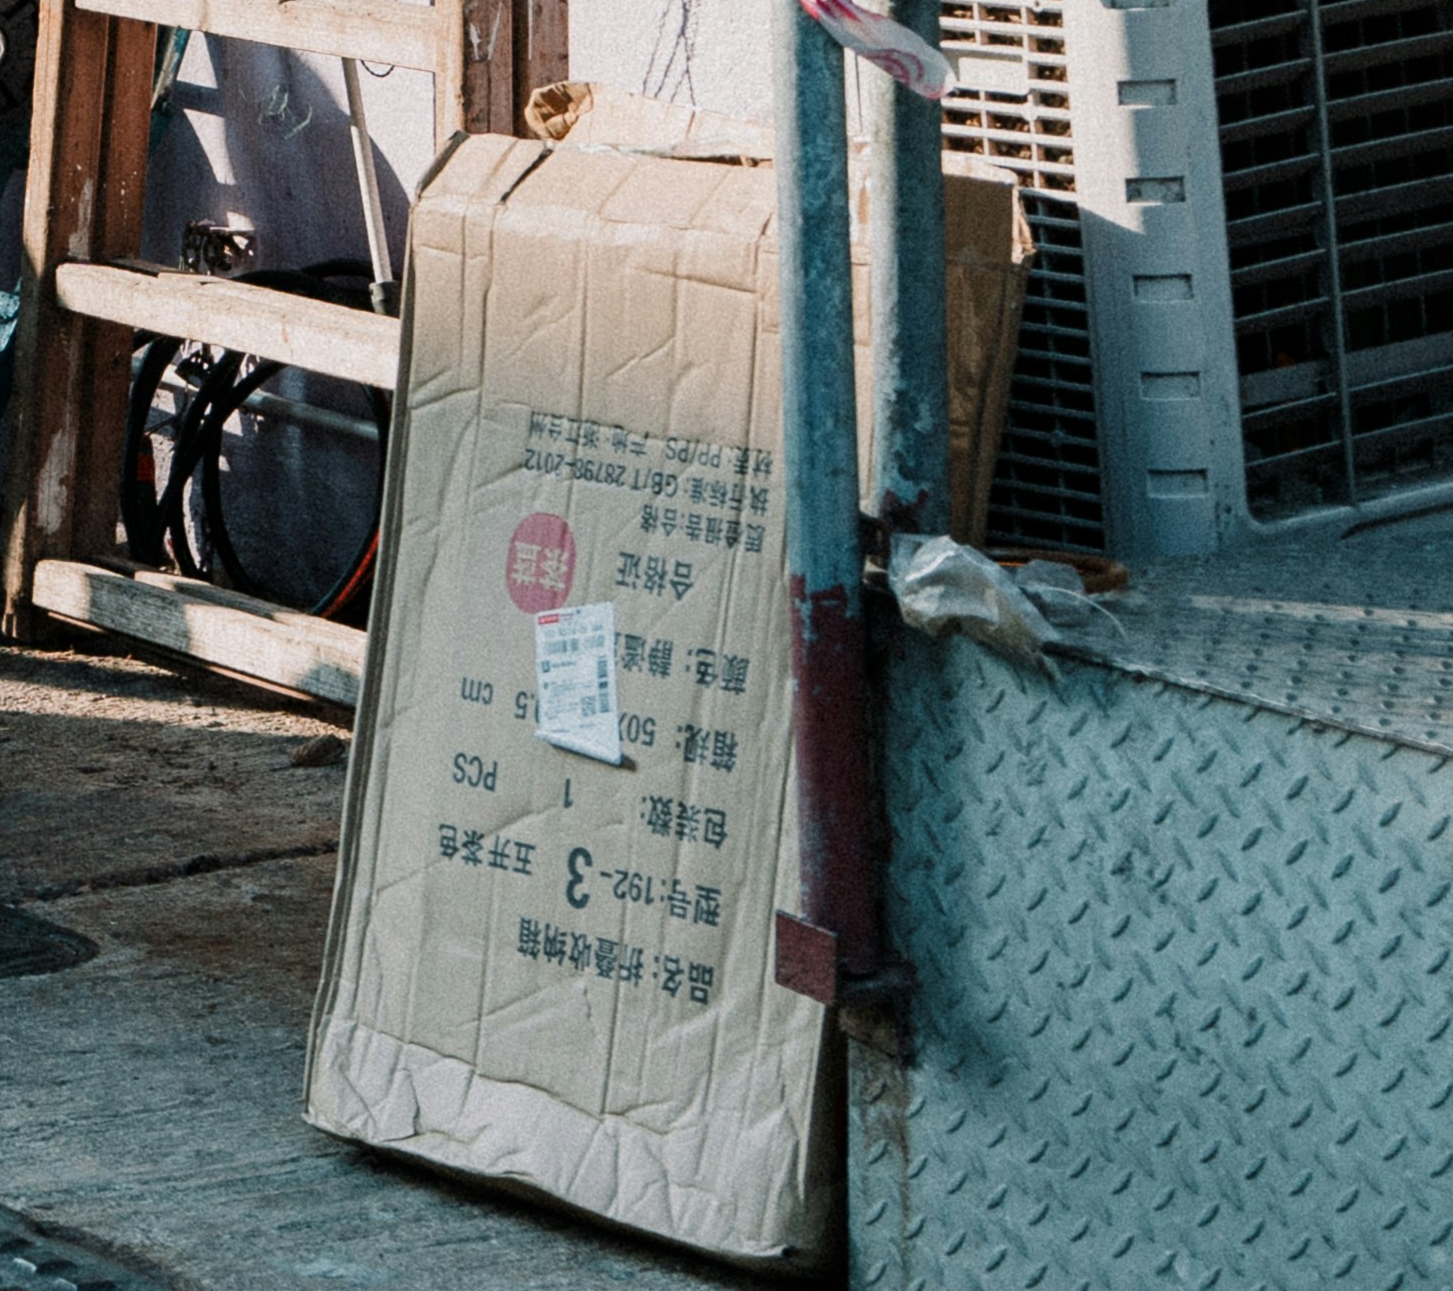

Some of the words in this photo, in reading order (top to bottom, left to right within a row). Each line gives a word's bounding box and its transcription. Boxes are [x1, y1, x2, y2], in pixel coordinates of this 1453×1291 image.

[614, 550, 694, 601] 合格证
[459, 676, 494, 707] cm
[451, 752, 498, 793] PCS
